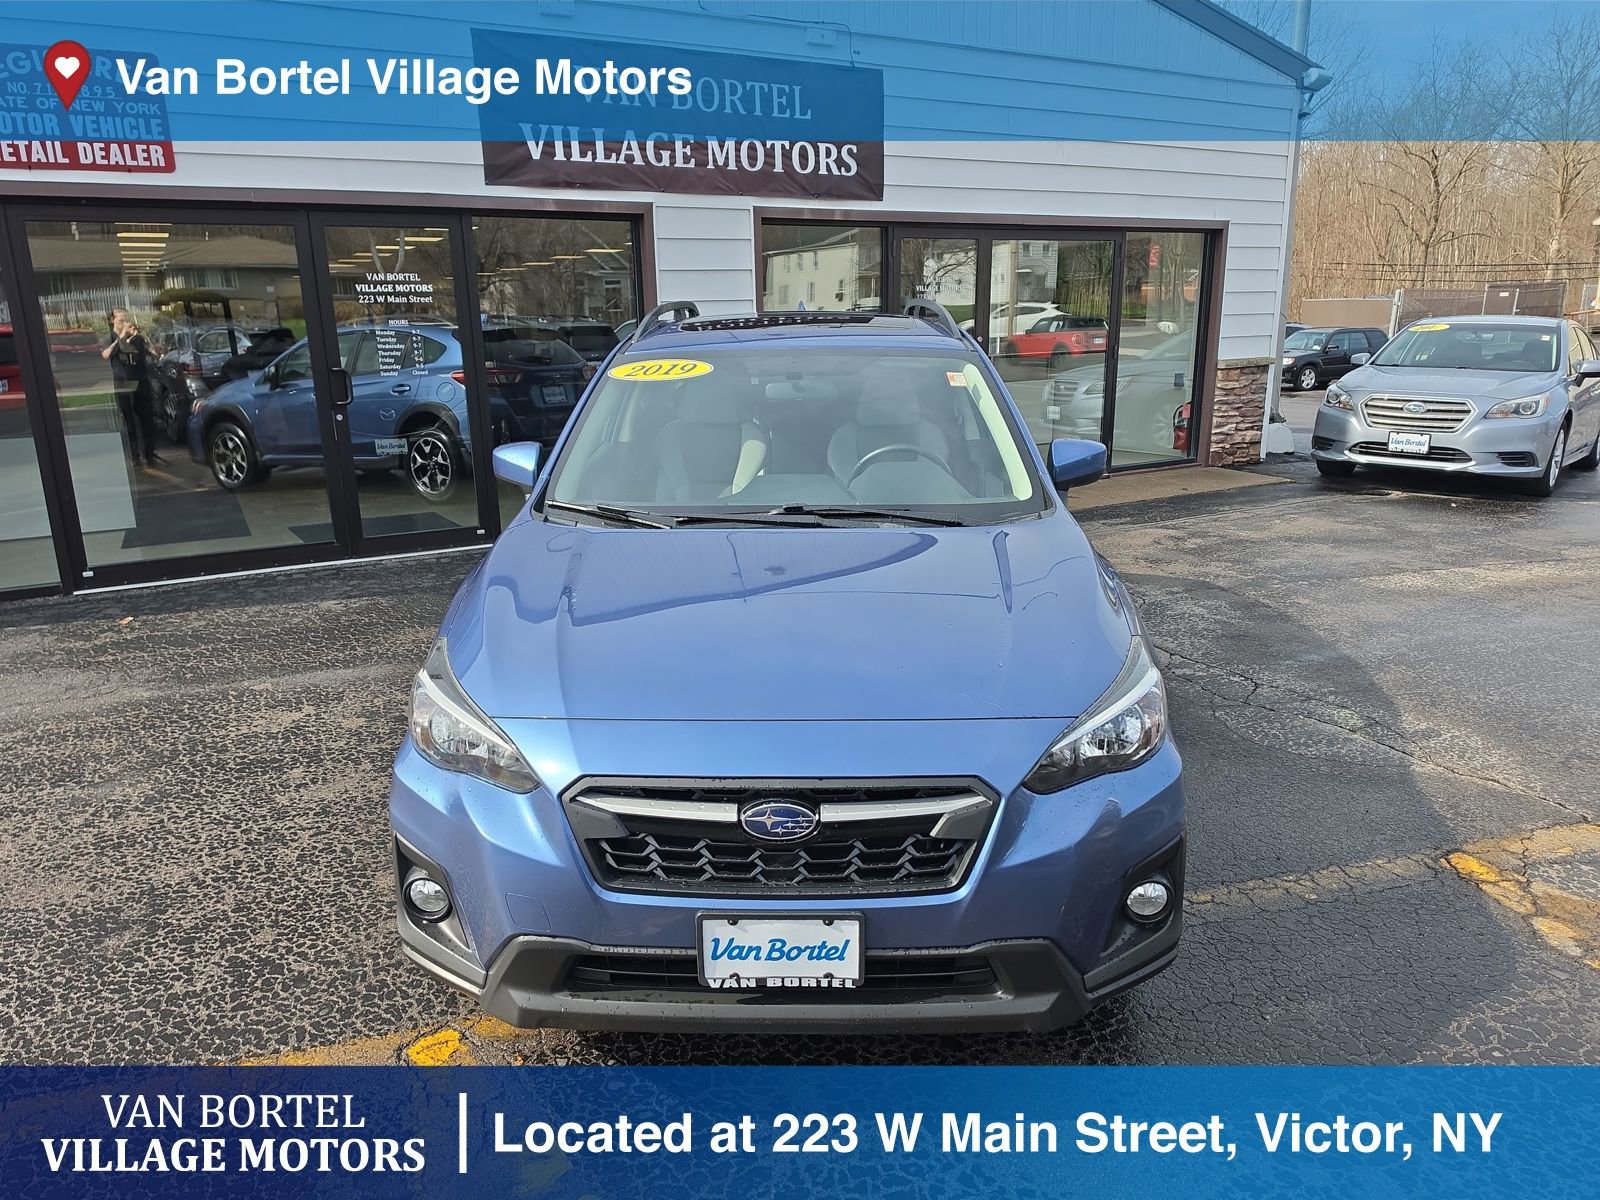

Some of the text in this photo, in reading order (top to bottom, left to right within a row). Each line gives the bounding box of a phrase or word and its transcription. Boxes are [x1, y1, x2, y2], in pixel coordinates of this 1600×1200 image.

[36, 97, 58, 110] OF
[70, 101, 105, 113] NEW
[113, 102, 161, 115] YORK
[0, 111, 165, 140] OTOR VEHICLE
[0, 140, 166, 167] ETAIL DEALER
[518, 122, 858, 177] VILLAGE MOTORS
[366, 273, 421, 281] VAN BORTEL
[355, 284, 433, 292] VILLAGE MOTORS
[358, 295, 433, 303] 223 W Main Street
[624, 363, 698, 377] 2019
[1391, 437, 1427, 447] Van Bortel
[710, 937, 851, 961] Van Bortel
[707, 977, 857, 989] VAN BORTEL
